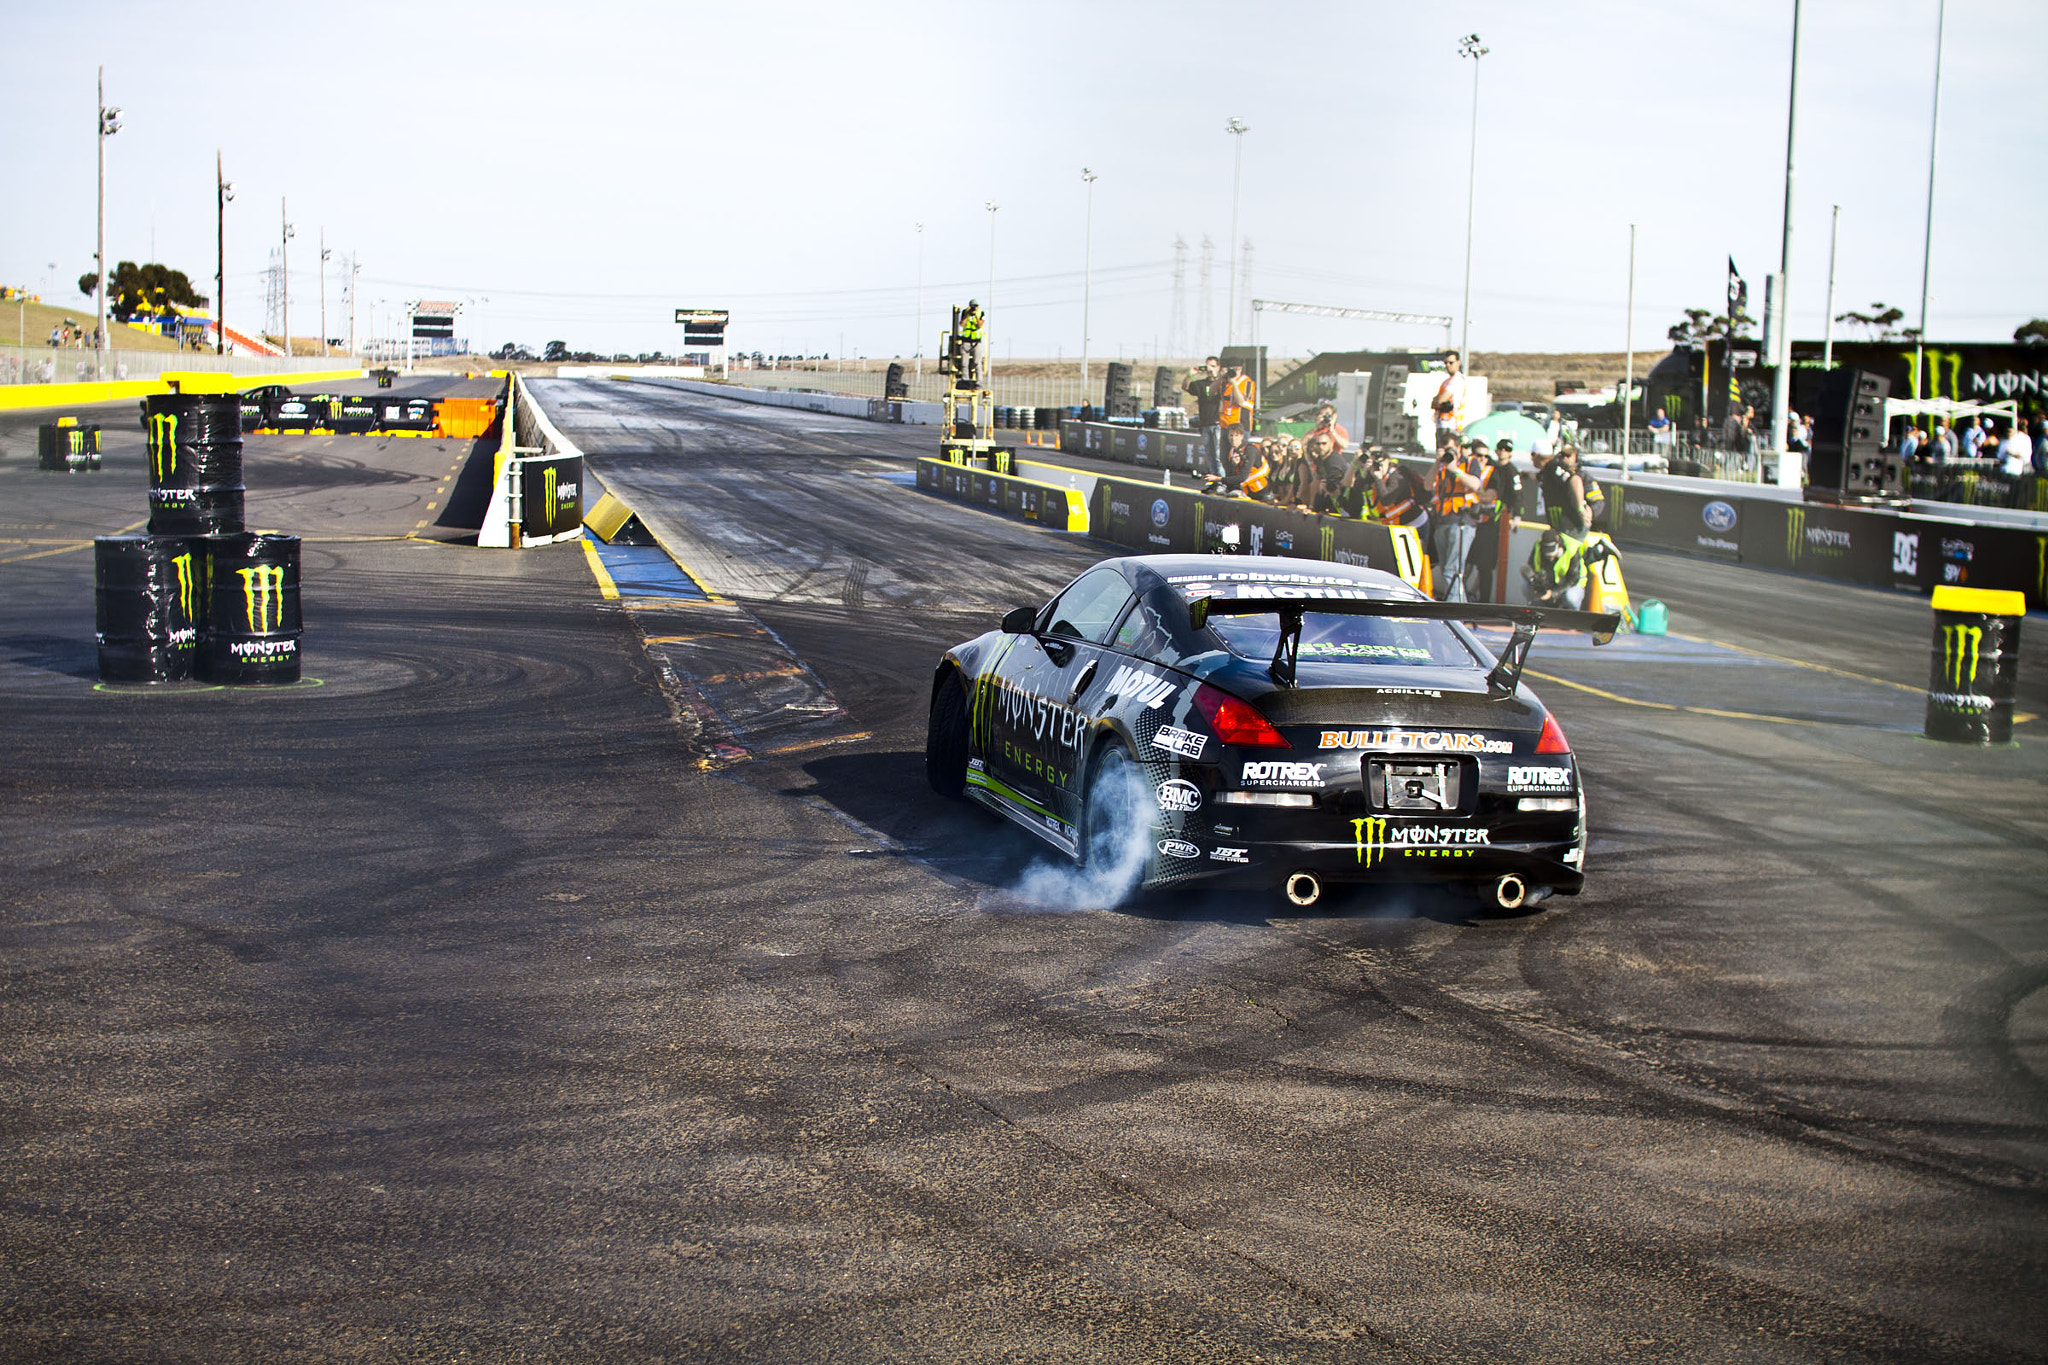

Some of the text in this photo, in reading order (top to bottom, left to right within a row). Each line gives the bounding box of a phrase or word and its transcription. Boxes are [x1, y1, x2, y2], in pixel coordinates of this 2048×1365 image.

[1275, 530, 1294, 541] GoPro
[1806, 527, 1851, 548] MONSTER
[230, 639, 297, 656] MONSTER
[241, 654, 290, 663] ENERGY
[1105, 664, 1177, 709] MOTUL
[998, 674, 1088, 760] MONSTER
[1159, 727, 1205, 746] BRAKE
[1173, 741, 1200, 756] LAB
[1005, 741, 1067, 788] ENERGY
[1242, 762, 1321, 780] ROTREX
[1507, 766, 1571, 785] ROTREX
[1161, 785, 1198, 806] BMC
[1391, 825, 1491, 845] MONSTER
[1162, 841, 1194, 855] PWR
[1210, 847, 1249, 857] JBT
[1404, 849, 1475, 857] ENERGY
